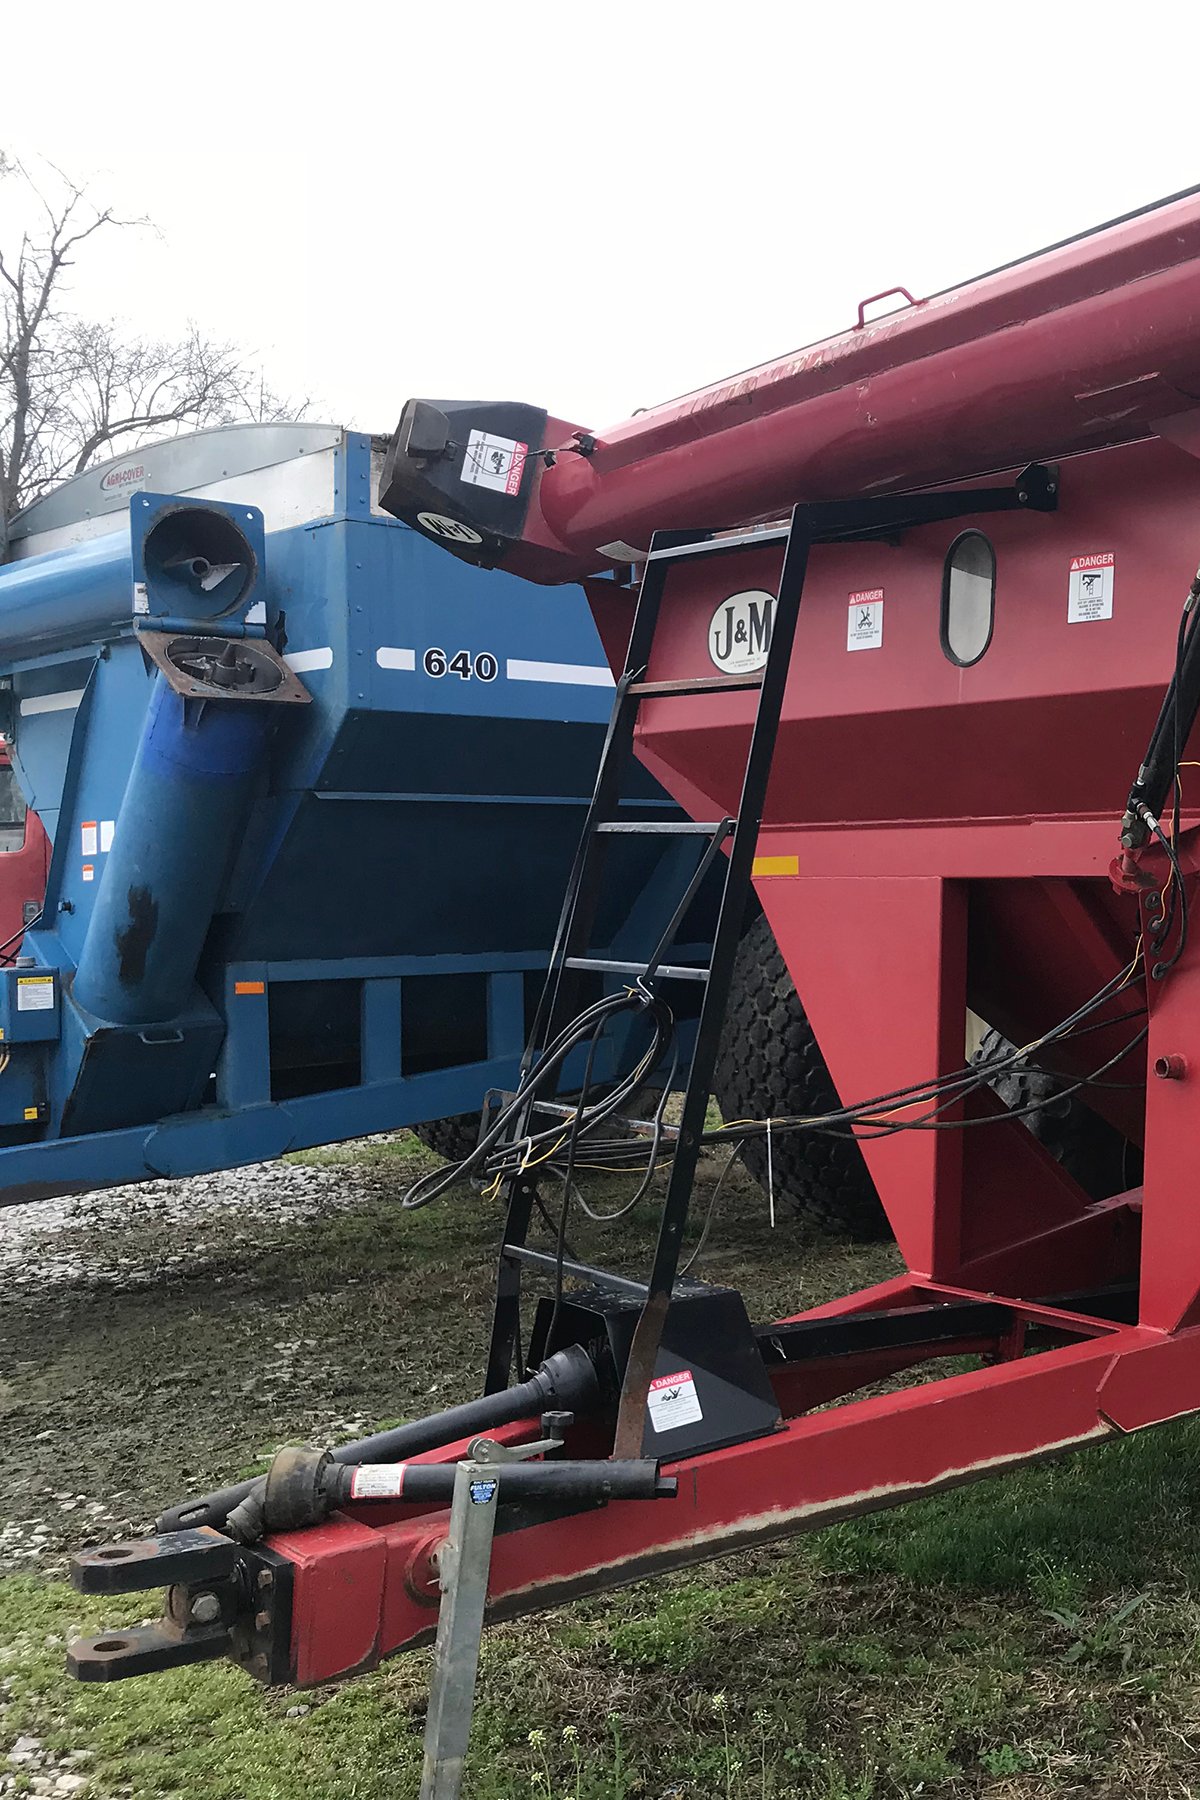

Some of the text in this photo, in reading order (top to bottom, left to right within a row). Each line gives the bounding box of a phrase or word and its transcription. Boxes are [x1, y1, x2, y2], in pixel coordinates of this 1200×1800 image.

[106, 465, 145, 487] AGRI-COVER
[506, 453, 524, 496] DANGER
[1079, 553, 1114, 568] DANGER
[855, 590, 884, 603] DANGER
[714, 599, 774, 661] J&M
[423, 647, 499, 682] 640
[655, 1372, 691, 1388] DANGER
[470, 1483, 496, 1491] FULTON
